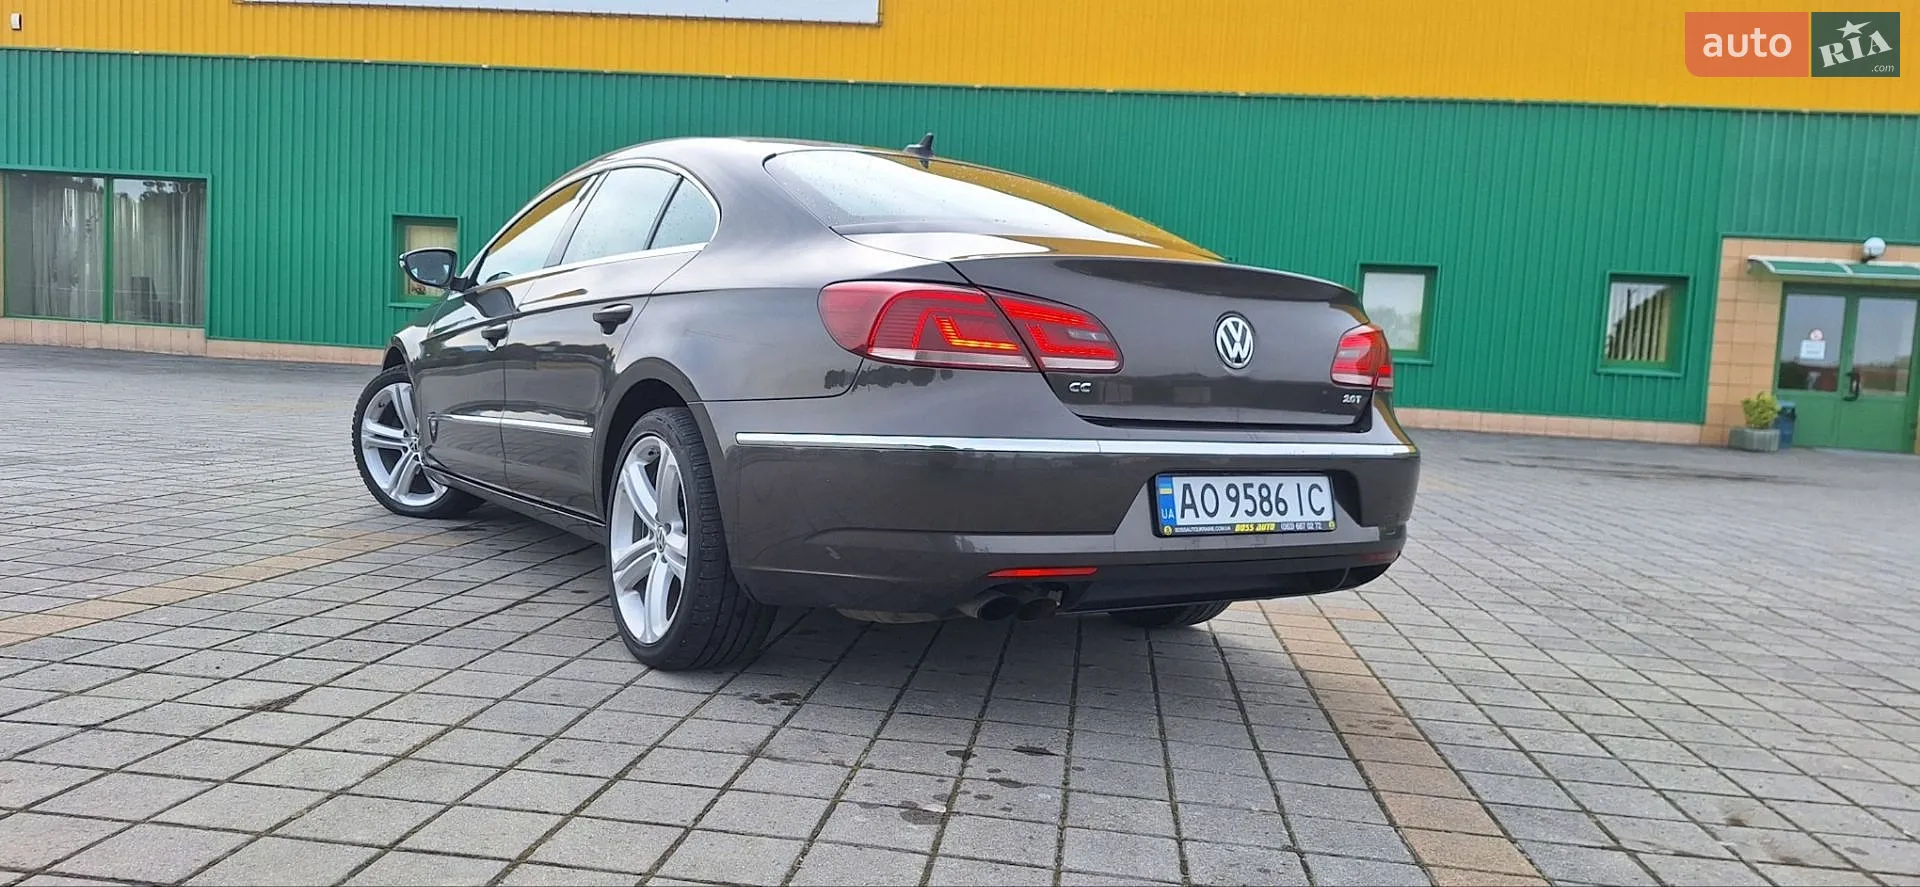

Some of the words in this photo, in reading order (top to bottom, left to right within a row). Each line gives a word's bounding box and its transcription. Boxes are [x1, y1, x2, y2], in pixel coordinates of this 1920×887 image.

[1069, 382, 1092, 393] CC
[1180, 483, 1220, 519] AO
[1225, 482, 1289, 518] 9586
[1297, 483, 1326, 517] IC
[1161, 508, 1175, 520] UA
[1234, 523, 1255, 532] BOSS
[1255, 522, 1276, 532] AUTO
